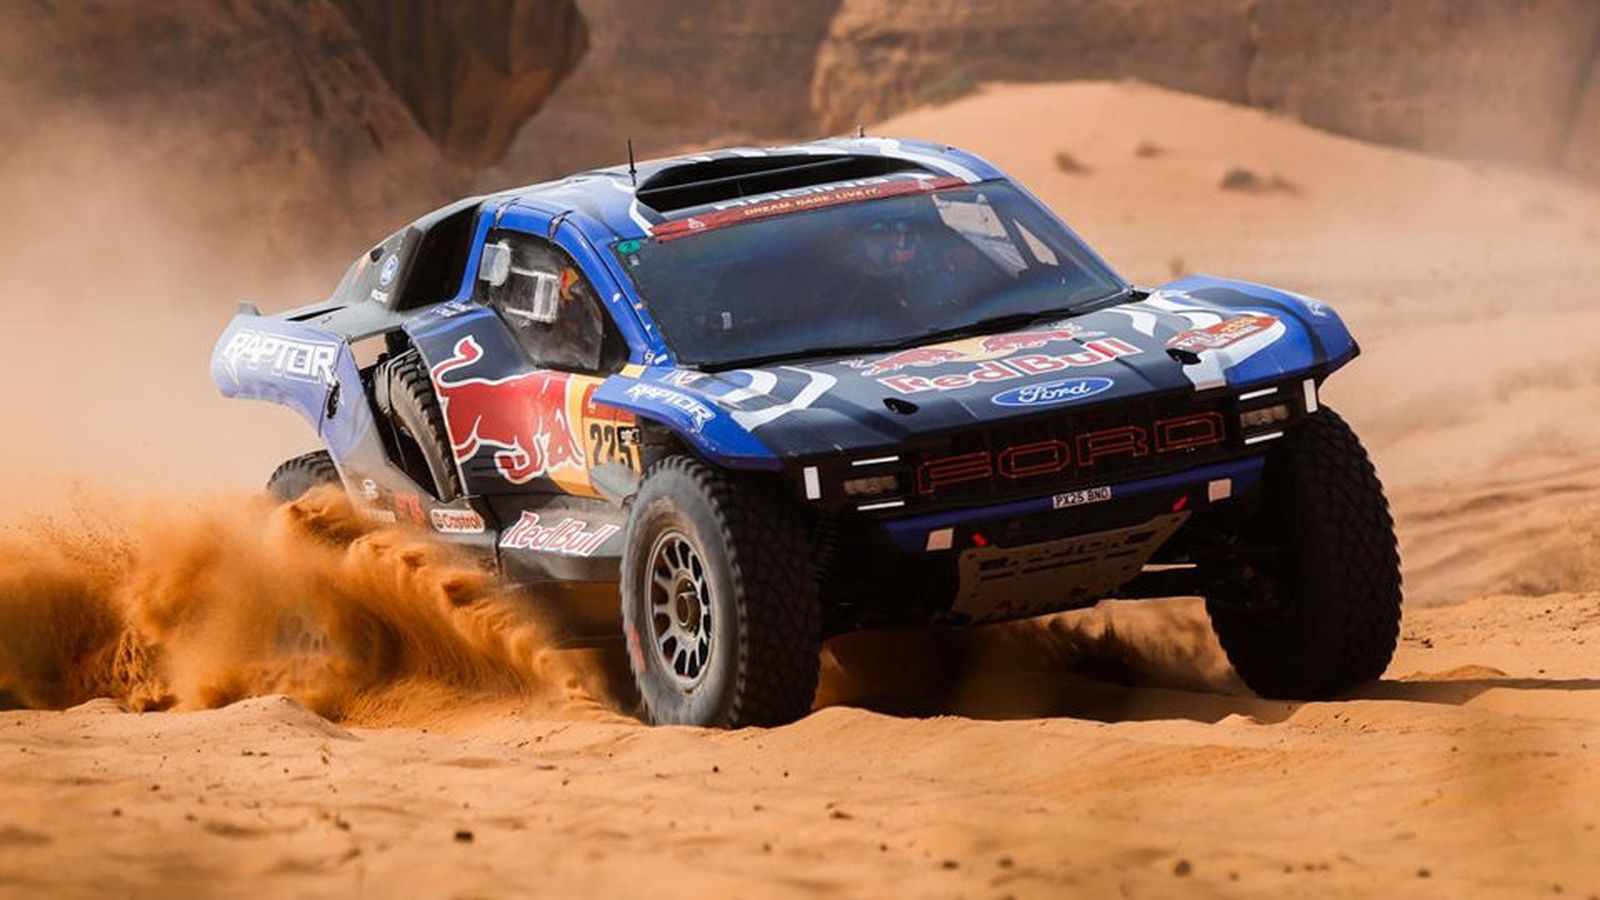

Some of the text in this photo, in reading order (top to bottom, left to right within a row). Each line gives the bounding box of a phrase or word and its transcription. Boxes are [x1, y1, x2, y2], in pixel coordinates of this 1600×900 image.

[223, 329, 339, 386] RAPTOR
[624, 382, 716, 433] RAPTOR
[1017, 379, 1091, 402] Ford
[916, 412, 1226, 495] FORD
[442, 513, 483, 530] Castrol
